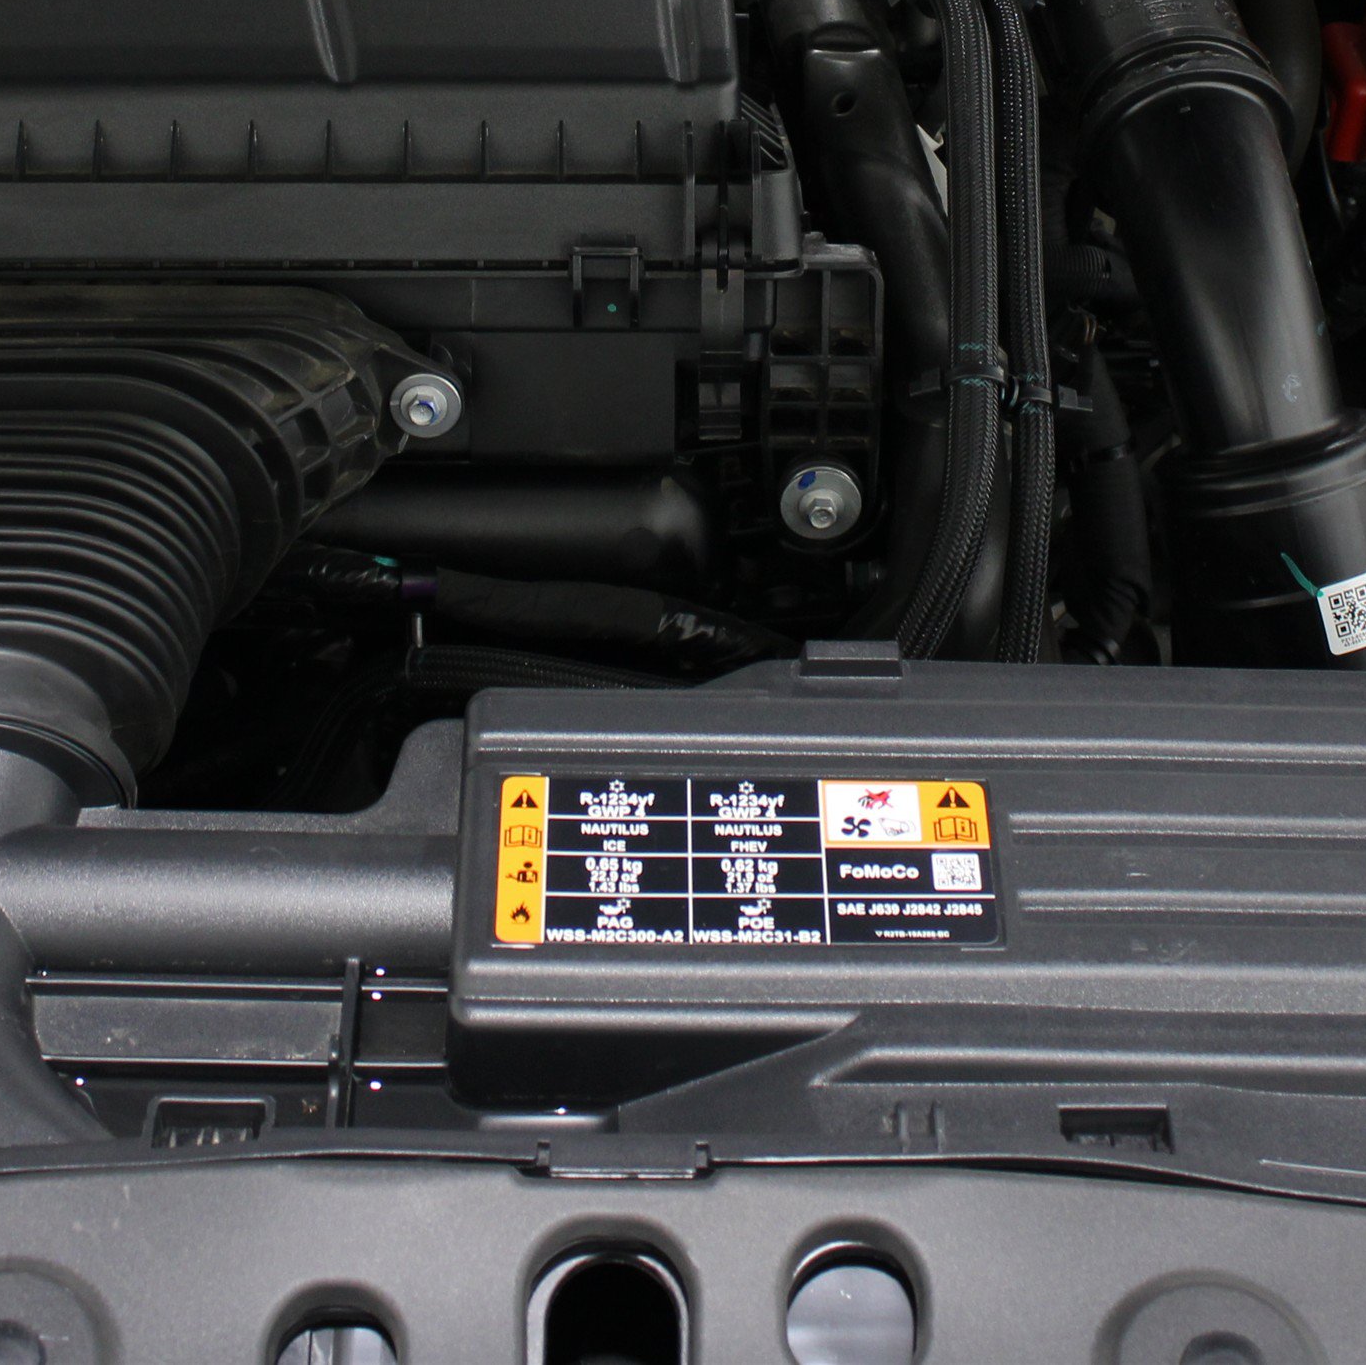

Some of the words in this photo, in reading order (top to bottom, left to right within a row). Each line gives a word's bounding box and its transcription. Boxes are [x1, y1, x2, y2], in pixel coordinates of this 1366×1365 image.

[579, 791, 655, 809] R-1234yf
[709, 793, 785, 809] R-1234yf
[587, 805, 632, 818] GWP
[718, 806, 762, 819] GWP
[580, 822, 649, 836] NAUTILUS
[714, 823, 783, 837] NAUTILUS
[602, 839, 627, 852] ICE
[730, 840, 768, 853] FHEV
[584, 856, 619, 872] 0.65
[622, 857, 644, 875] kg
[720, 858, 754, 873] 0.62
[757, 859, 779, 876] kg
[839, 863, 920, 879] FoMoCo
[590, 870, 619, 883] 22.9
[621, 872, 638, 883] oz
[726, 871, 755, 884] 21.9
[757, 873, 774, 884] oz
[588, 881, 616, 893] 1.43
[618, 881, 640, 894] lbs
[724, 882, 752, 894] 1.37
[755, 882, 776, 894] lbs
[836, 902, 866, 916] SAE
[596, 915, 634, 930] PAG
[737, 916, 775, 930] POE
[546, 928, 684, 943] WSS-M2C300-A2
[693, 929, 821, 944] WSS-M2C31-B2
